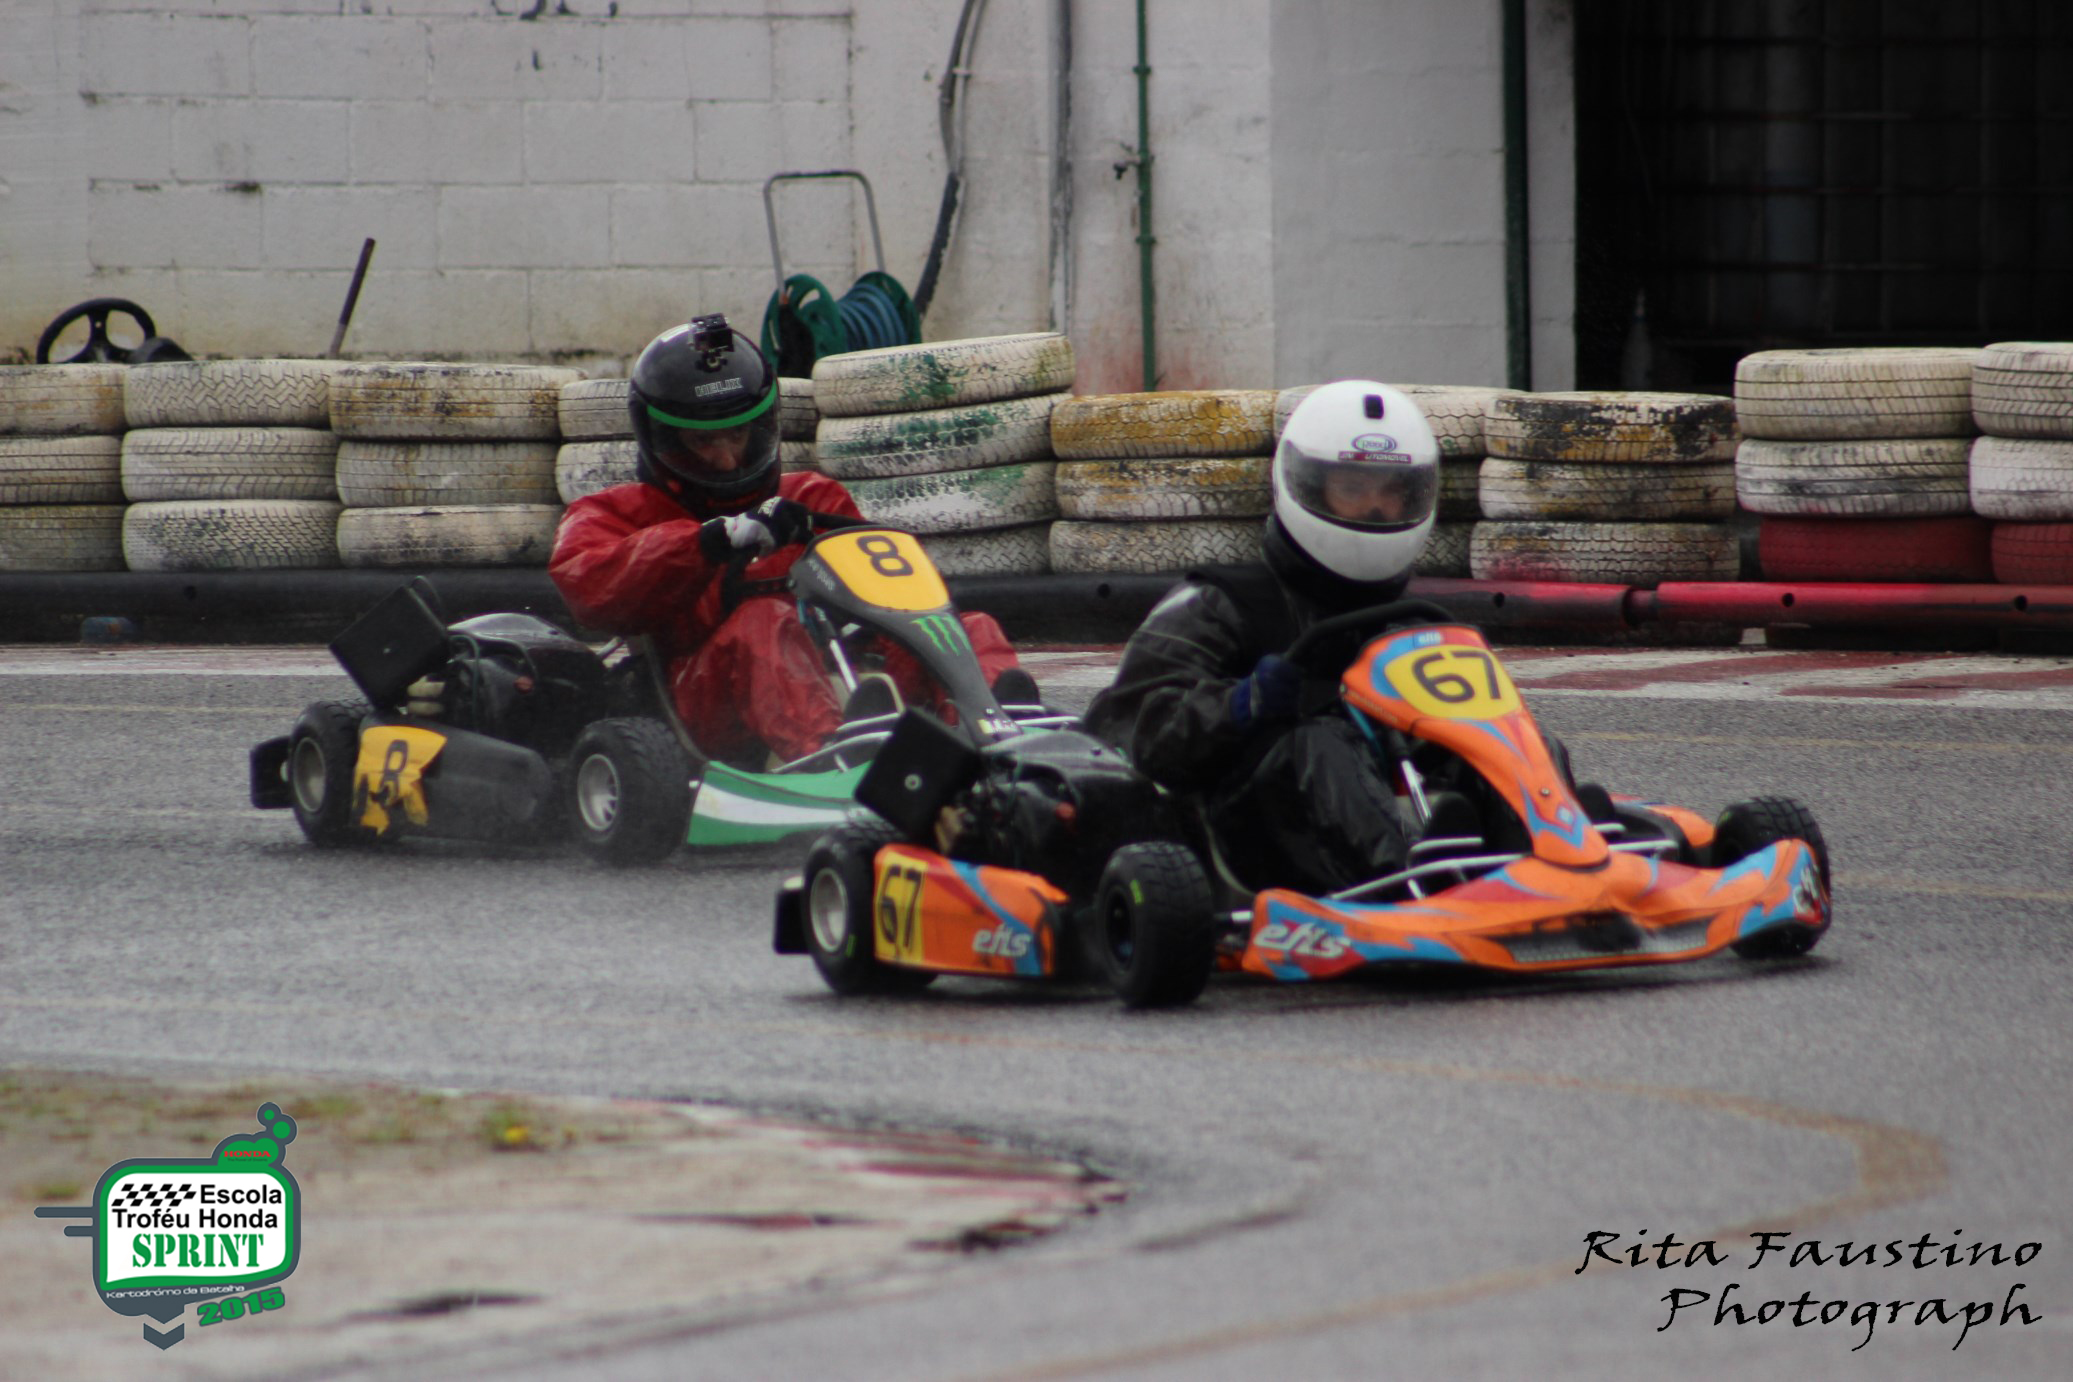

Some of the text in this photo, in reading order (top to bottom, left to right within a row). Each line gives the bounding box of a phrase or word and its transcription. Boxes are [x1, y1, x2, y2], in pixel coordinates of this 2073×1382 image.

[856, 535, 914, 577] 8
[1411, 650, 1502, 704] 67
[880, 864, 922, 949] 67
